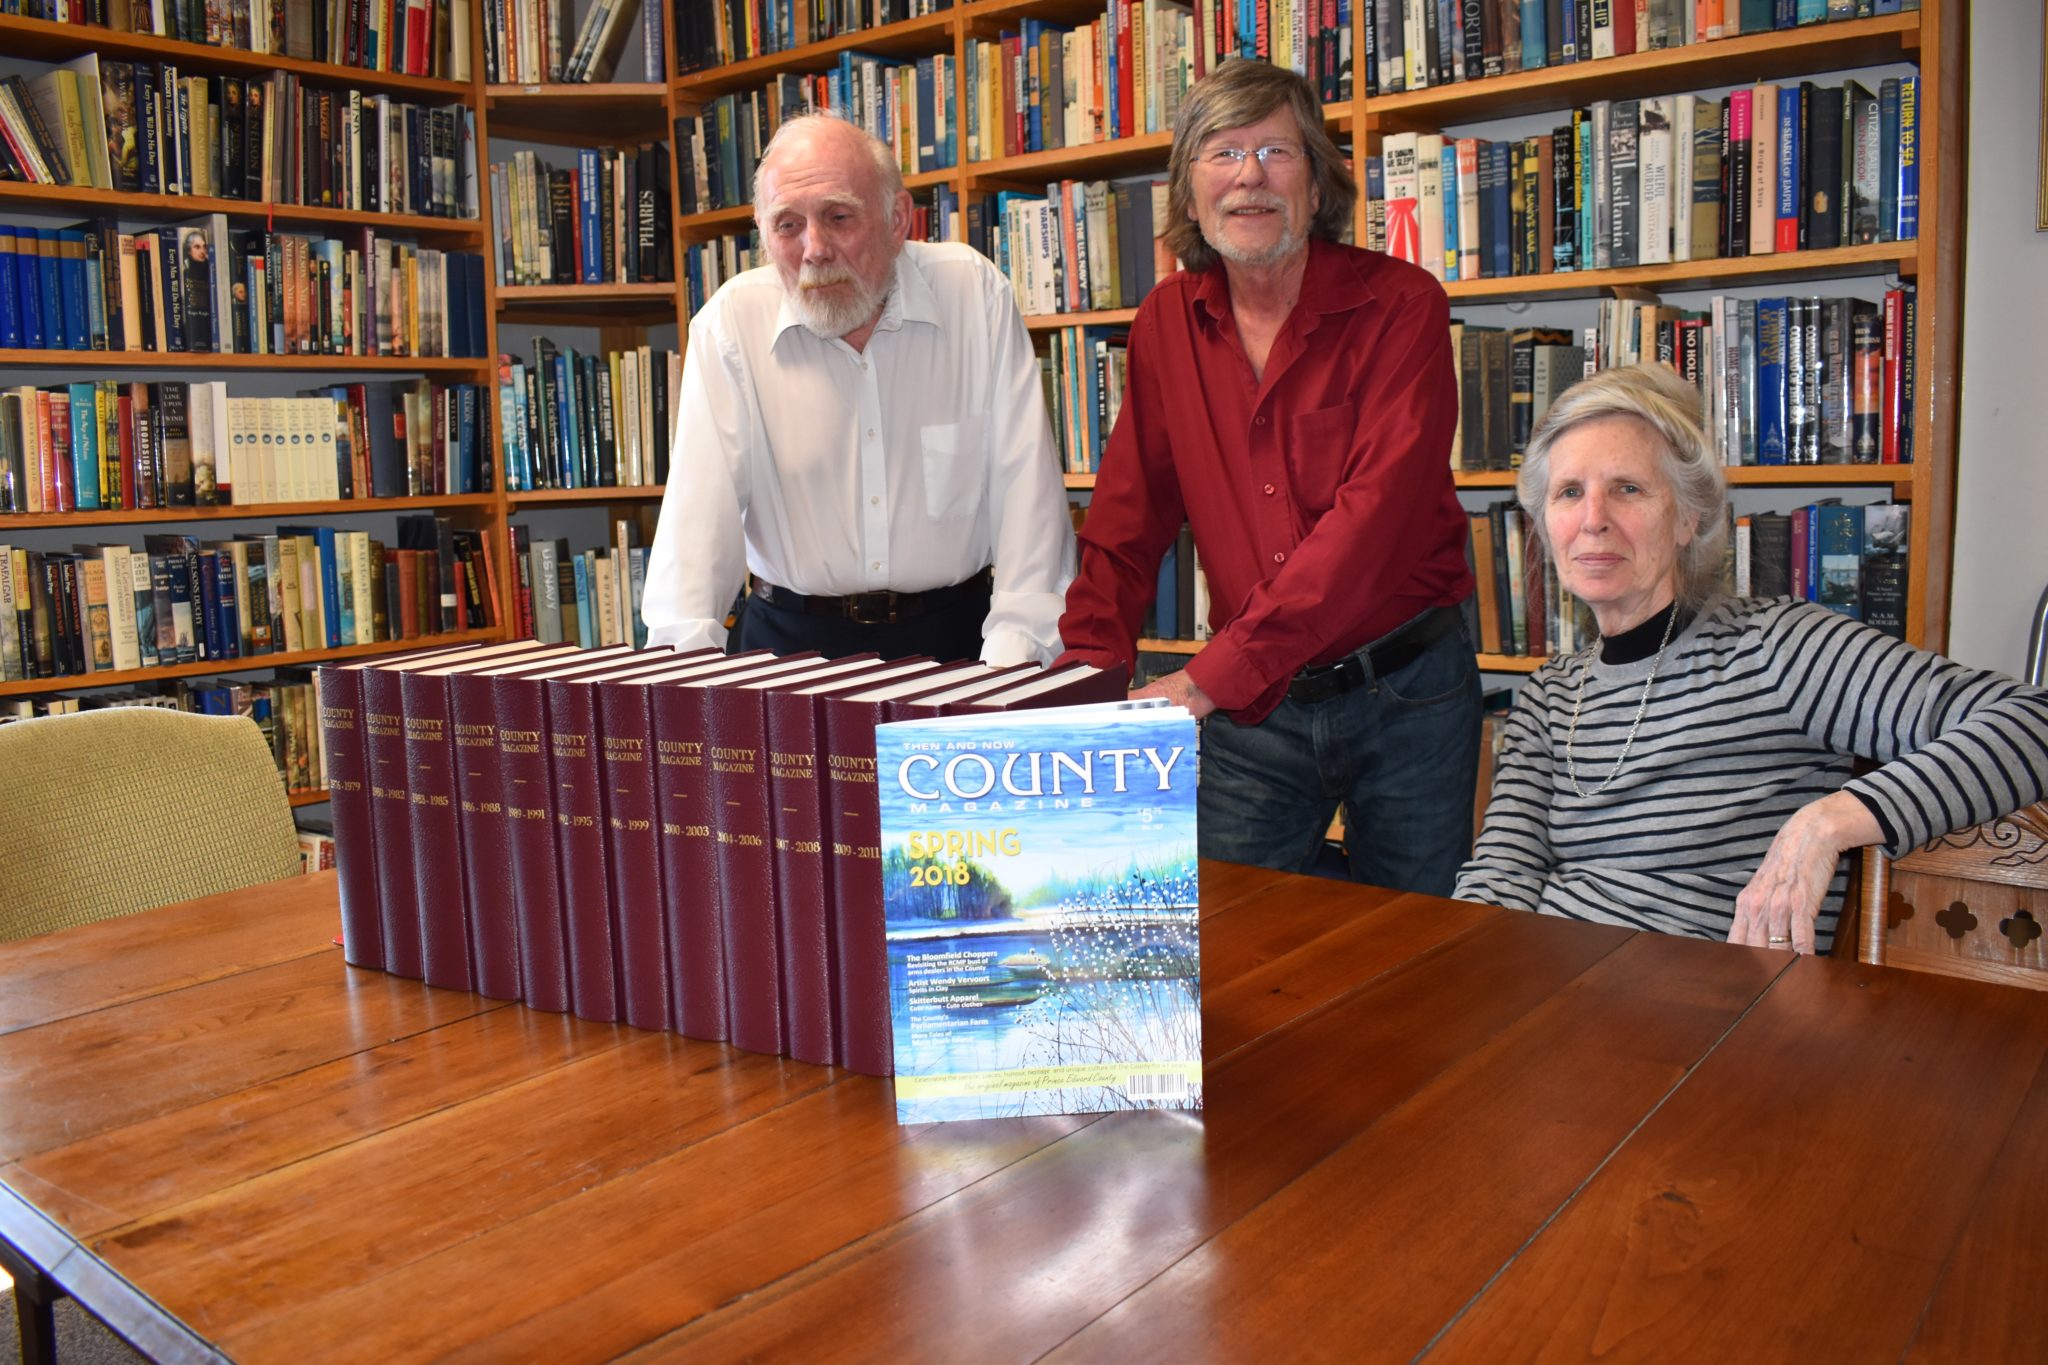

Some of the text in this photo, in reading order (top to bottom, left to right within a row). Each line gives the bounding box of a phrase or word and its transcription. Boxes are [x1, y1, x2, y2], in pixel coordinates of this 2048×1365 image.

[143, 84, 152, 100] Every
[352, 93, 360, 135] NELSON
[1721, 107, 1729, 129] THOSE
[1902, 83, 1915, 167] RETURN TO SEA
[148, 130, 154, 138] Do
[250, 120, 260, 168] NELSON
[1858, 116, 1867, 181] GLYN PRYSOR
[1868, 102, 1879, 195] CITIZEN SAILORS
[148, 151, 156, 165] Duty
[1397, 157, 1415, 166] SLEPT
[1757, 149, 1765, 174] Bridge
[1783, 117, 1792, 214] IN SEARCH OF EMPIRE
[1644, 163, 1655, 203] MURDER
[1654, 165, 1665, 199] WILFUL
[1611, 162, 1636, 249] Lusitania
[1757, 188, 1765, 208] Ships
[639, 190, 654, 247] PHARES
[1040, 206, 1050, 260] WARSHIPS
[1527, 230, 1537, 254] WAR
[166, 248, 176, 264] Every
[285, 240, 294, 277] NELSON
[1076, 221, 1087, 289] THE NAVY
[299, 242, 308, 307] NELSON NILE
[172, 293, 179, 302] Do
[172, 314, 181, 328] Duty
[1686, 329, 1696, 347] NO
[1790, 325, 1801, 423] COMMAND OF THE SEA
[1805, 325, 1816, 422] COMMAND OF THE SEA
[1728, 374, 1739, 419] SQUADRON
[80, 409, 88, 421] The
[463, 390, 471, 423] NELSON
[546, 383, 557, 434] The Golden
[140, 420, 151, 477] BROADSIDES
[359, 537, 369, 594] TRAFALGAR
[0, 552, 12, 604] TRAFALGAR
[542, 548, 556, 610] US NAVY
[194, 595, 202, 625] DUCHY
[367, 713, 401, 725] COUNTY
[406, 717, 443, 730] COUNTY
[407, 730, 443, 741] MAGAZINE
[455, 723, 496, 735] COUNTY
[500, 730, 541, 742] COUNTY
[456, 736, 494, 747] MAGAZINE
[501, 743, 540, 753] MAGAZINE
[604, 736, 644, 750] COUNTY
[658, 740, 704, 754] COUNTY
[903, 740, 1015, 751] THEN AND NOW
[659, 755, 702, 766] MAGAZINE
[711, 746, 756, 761] COUNTY
[770, 751, 814, 766] COUNTY
[829, 754, 876, 770] COUNTY
[713, 761, 755, 773] MAGAZINE
[771, 767, 813, 779] MAGAZINE
[898, 746, 1185, 800] COUNTY
[830, 770, 876, 782] MAGAZINE
[910, 797, 1096, 814] MAGAZINE
[908, 828, 1022, 860] SPRING
[910, 862, 970, 887] 2018
[922, 952, 961, 960] Bloomfield
[963, 950, 998, 958] Choppers
[965, 965, 986, 973] County
[909, 979, 928, 987] Artist
[930, 977, 955, 986] Wendy
[909, 994, 979, 1005] Skitterbutt Apparel
[911, 1019, 969, 1029] Parliamentarian
[923, 1014, 949, 1022] County's
[1042, 1073, 1117, 1086] Prince Edward County
